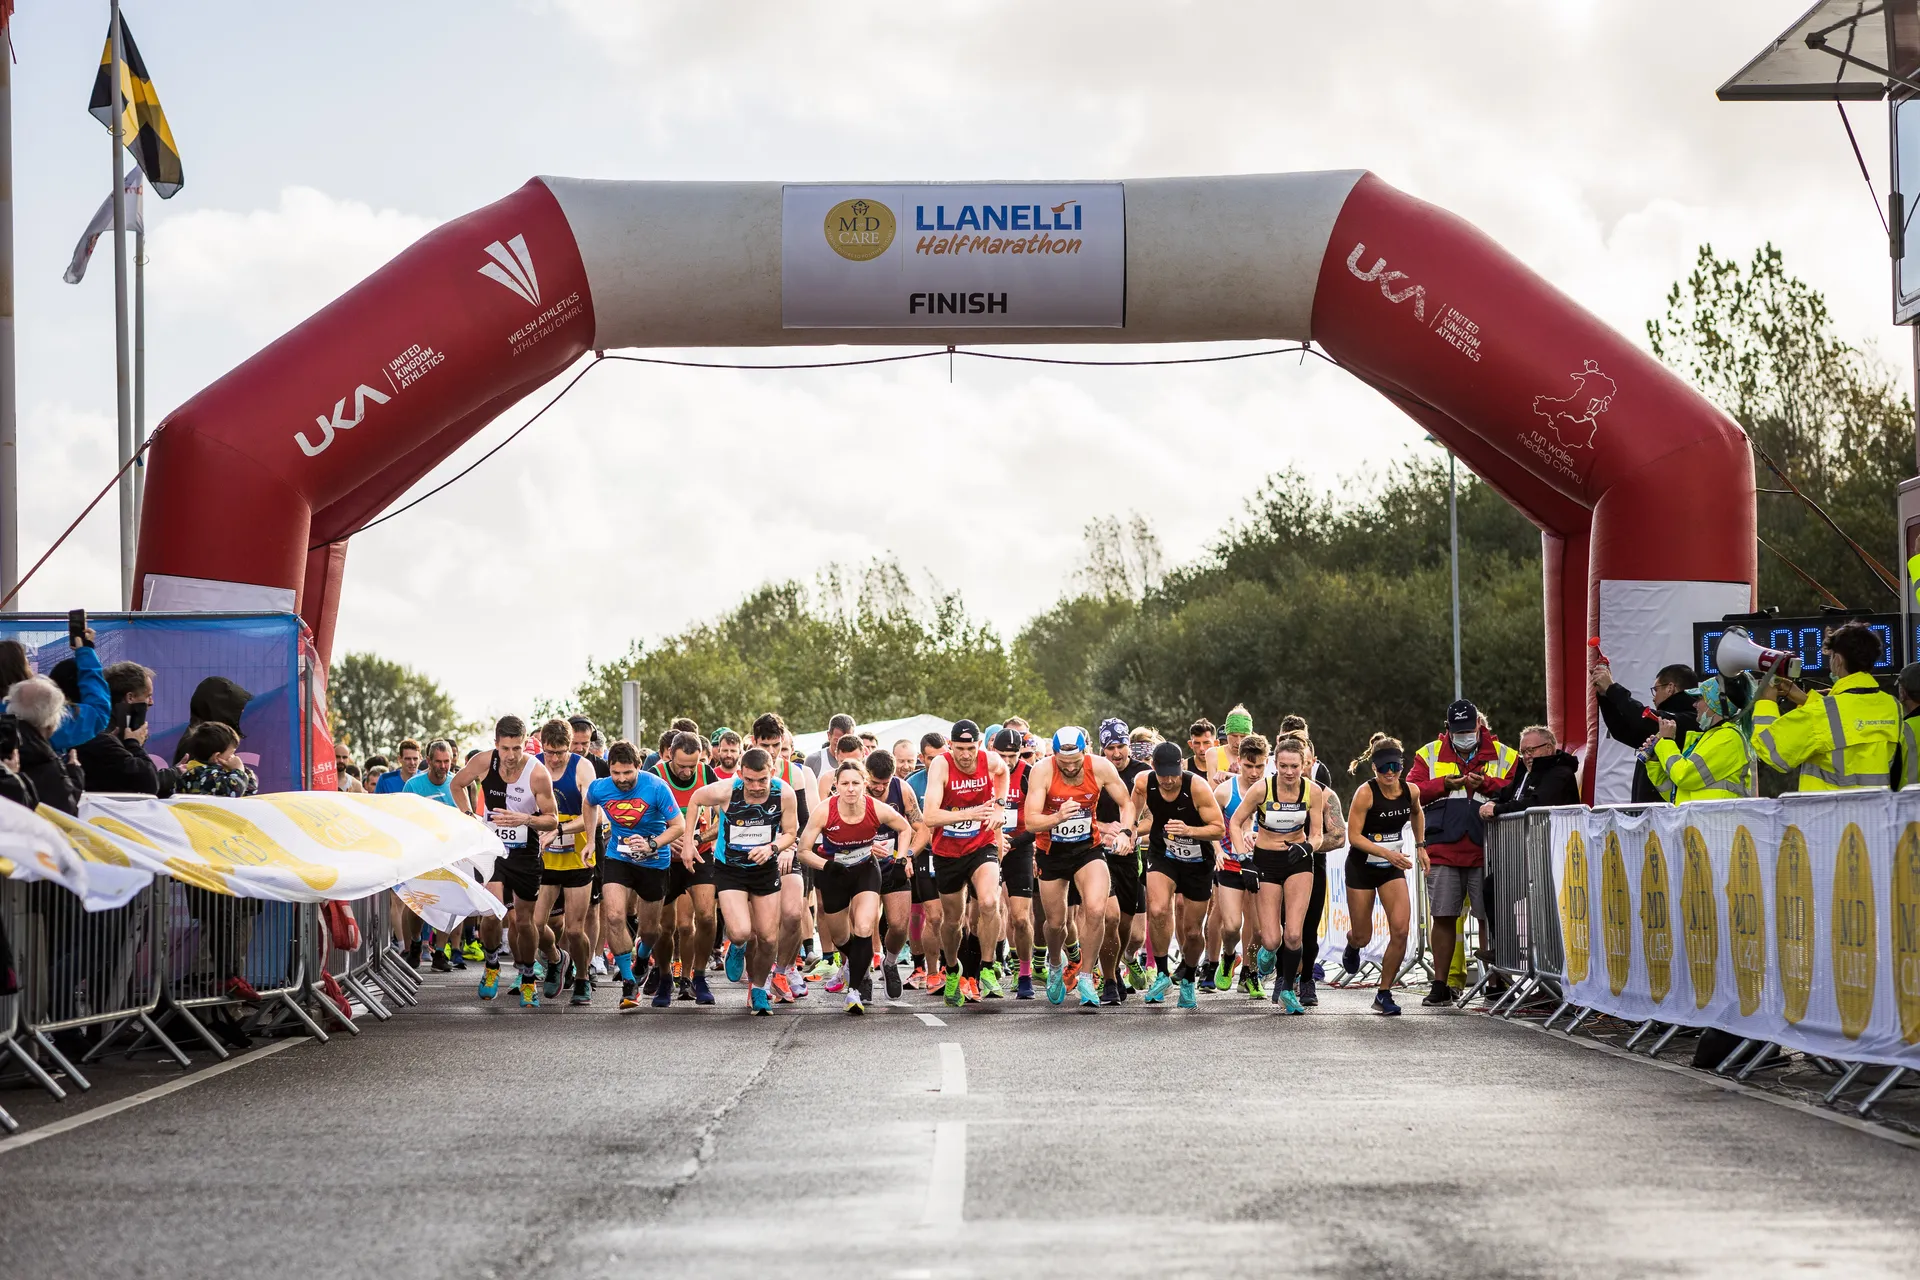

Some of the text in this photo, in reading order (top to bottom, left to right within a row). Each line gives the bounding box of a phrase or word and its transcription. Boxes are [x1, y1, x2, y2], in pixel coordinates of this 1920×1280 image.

[915, 203, 1082, 231] LLANELLI
[838, 232, 880, 244] CARE
[1346, 242, 1426, 323] UKA
[507, 291, 580, 345] WELSH ATHLETICS
[909, 292, 1008, 315] FINISH
[1446, 307, 1480, 335] UNITED
[512, 323, 555, 357] ATHLETAU
[1434, 326, 1483, 363] ATHLETICS
[1440, 317, 1482, 350] KINGDOM
[388, 343, 421, 371] UNITED
[394, 346, 435, 381] KINGDOM
[400, 351, 446, 390] ATHLETICS
[293, 383, 392, 457] UKA
[1516, 432, 1583, 485] rhedeg cymru
[1530, 430, 1575, 468] run wales
[951, 775, 988, 791] LLANELLI
[1053, 824, 1085, 836] 1043
[1379, 807, 1411, 818] AGILIS
[1169, 844, 1192, 857] 519
[1839, 898, 1868, 948] MD
[1899, 902, 1920, 953] M
[1839, 950, 1868, 989] CARE
[1900, 956, 1920, 997] CA
